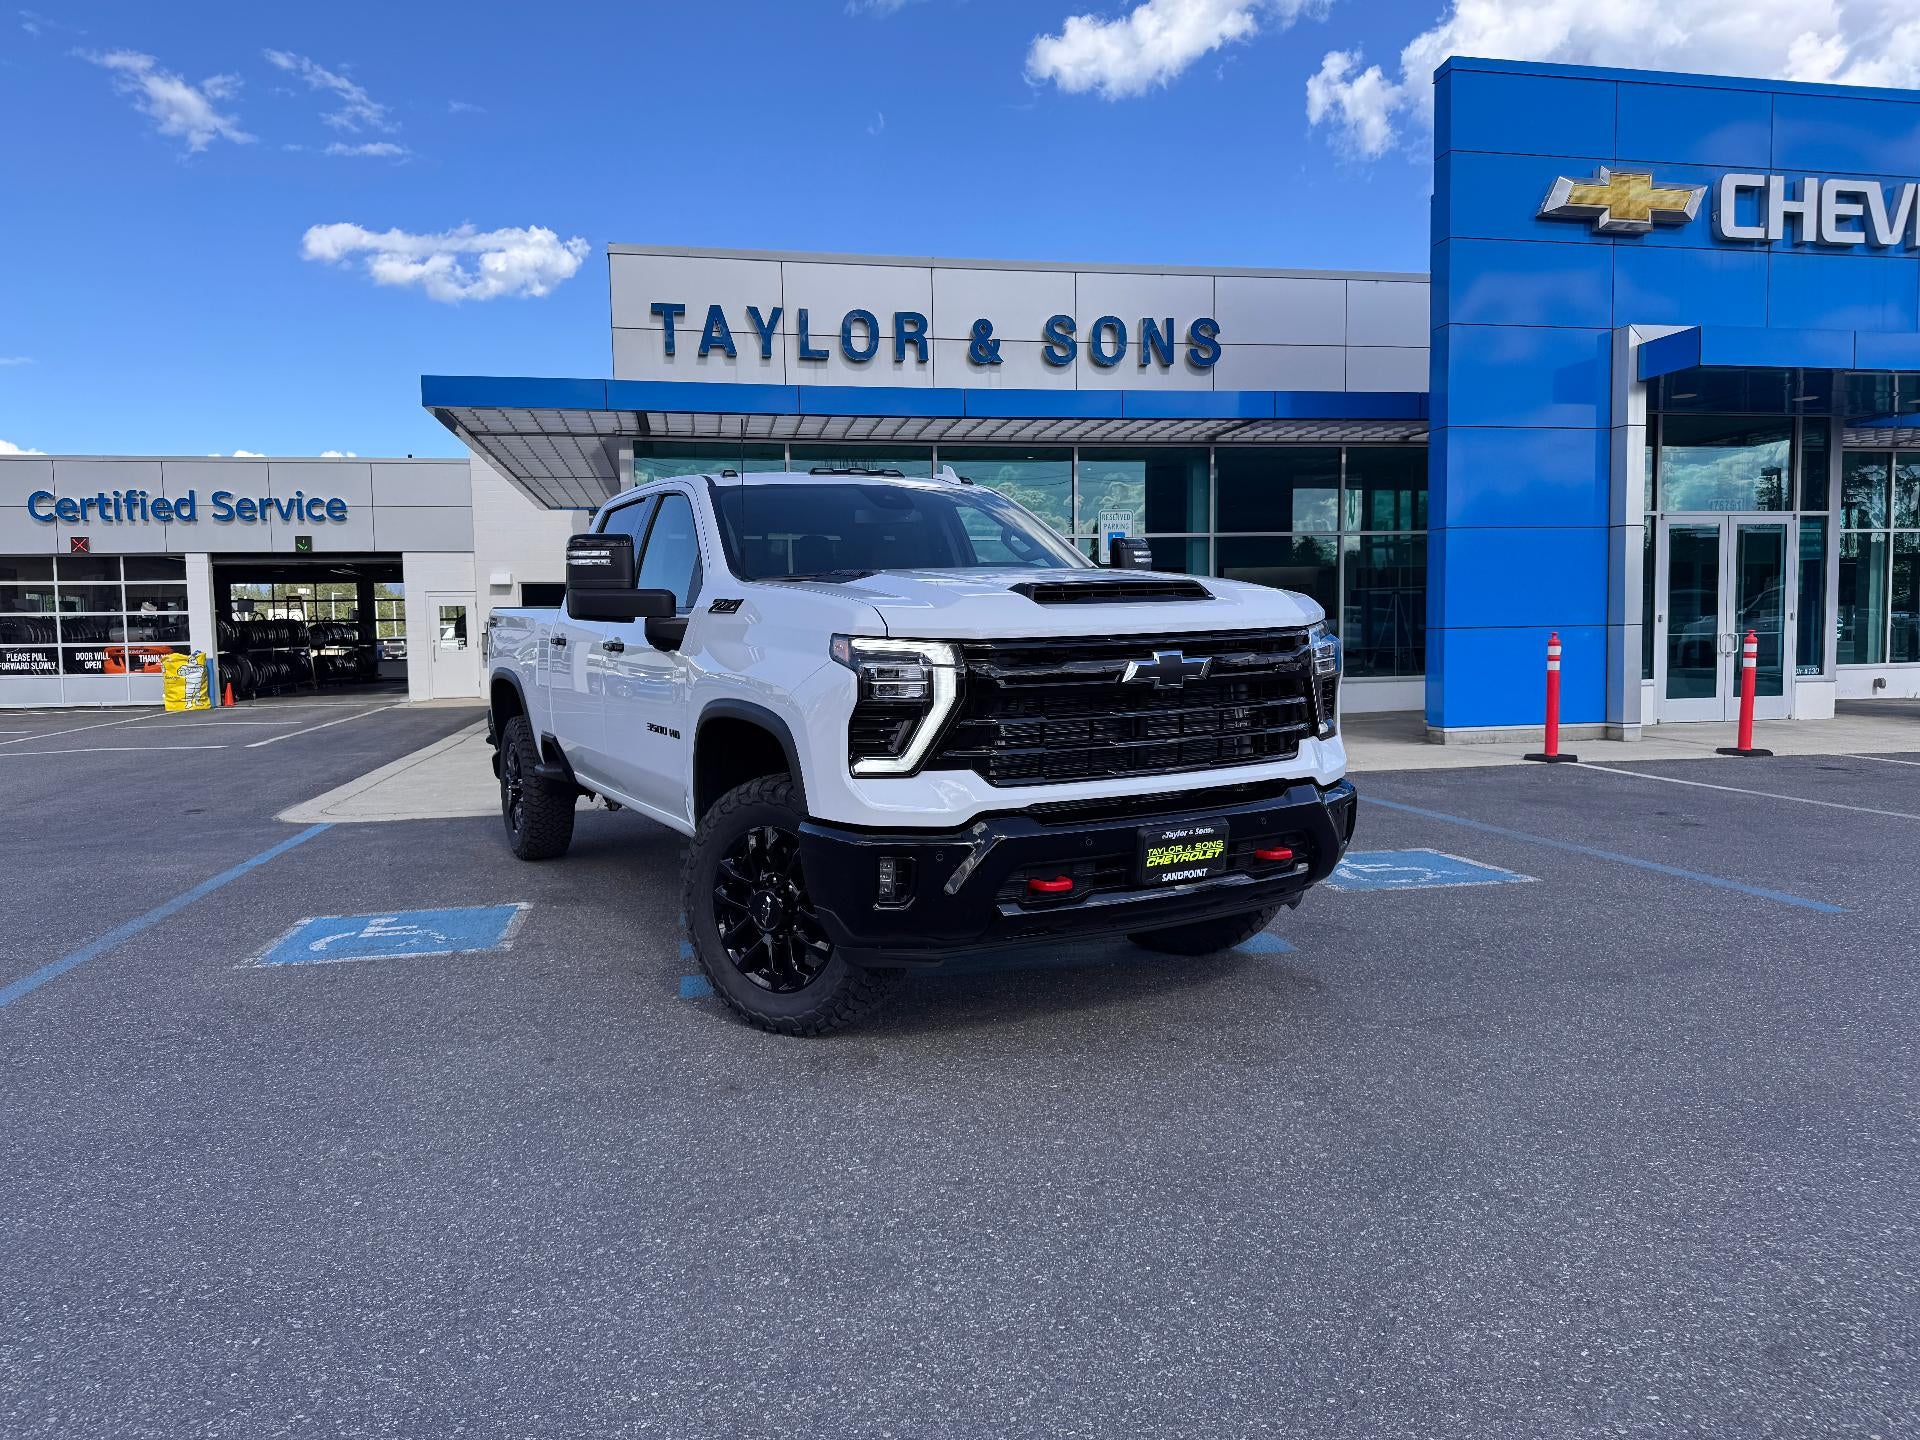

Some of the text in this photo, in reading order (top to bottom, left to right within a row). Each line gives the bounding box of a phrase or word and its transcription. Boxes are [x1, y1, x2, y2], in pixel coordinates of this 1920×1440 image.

[1715, 174, 1920, 247] CHEV
[650, 302, 1223, 368] TAYLOR & SONS
[28, 490, 348, 523] Certified Service
[6, 652, 48, 662] PLEASE PULL
[75, 652, 94, 662] DOOR
[94, 652, 110, 661] WILL
[138, 654, 161, 664] THANK
[30, 661, 56, 670] SLOWLY
[84, 661, 102, 669] OPEN
[646, 722, 680, 740] 3500 HD
[1164, 829, 1188, 840] Taylor
[1147, 840, 1224, 857] TAYLOR & SONS
[1146, 848, 1224, 868] CHEVROLET
[1161, 868, 1208, 882] SANDPOINT
